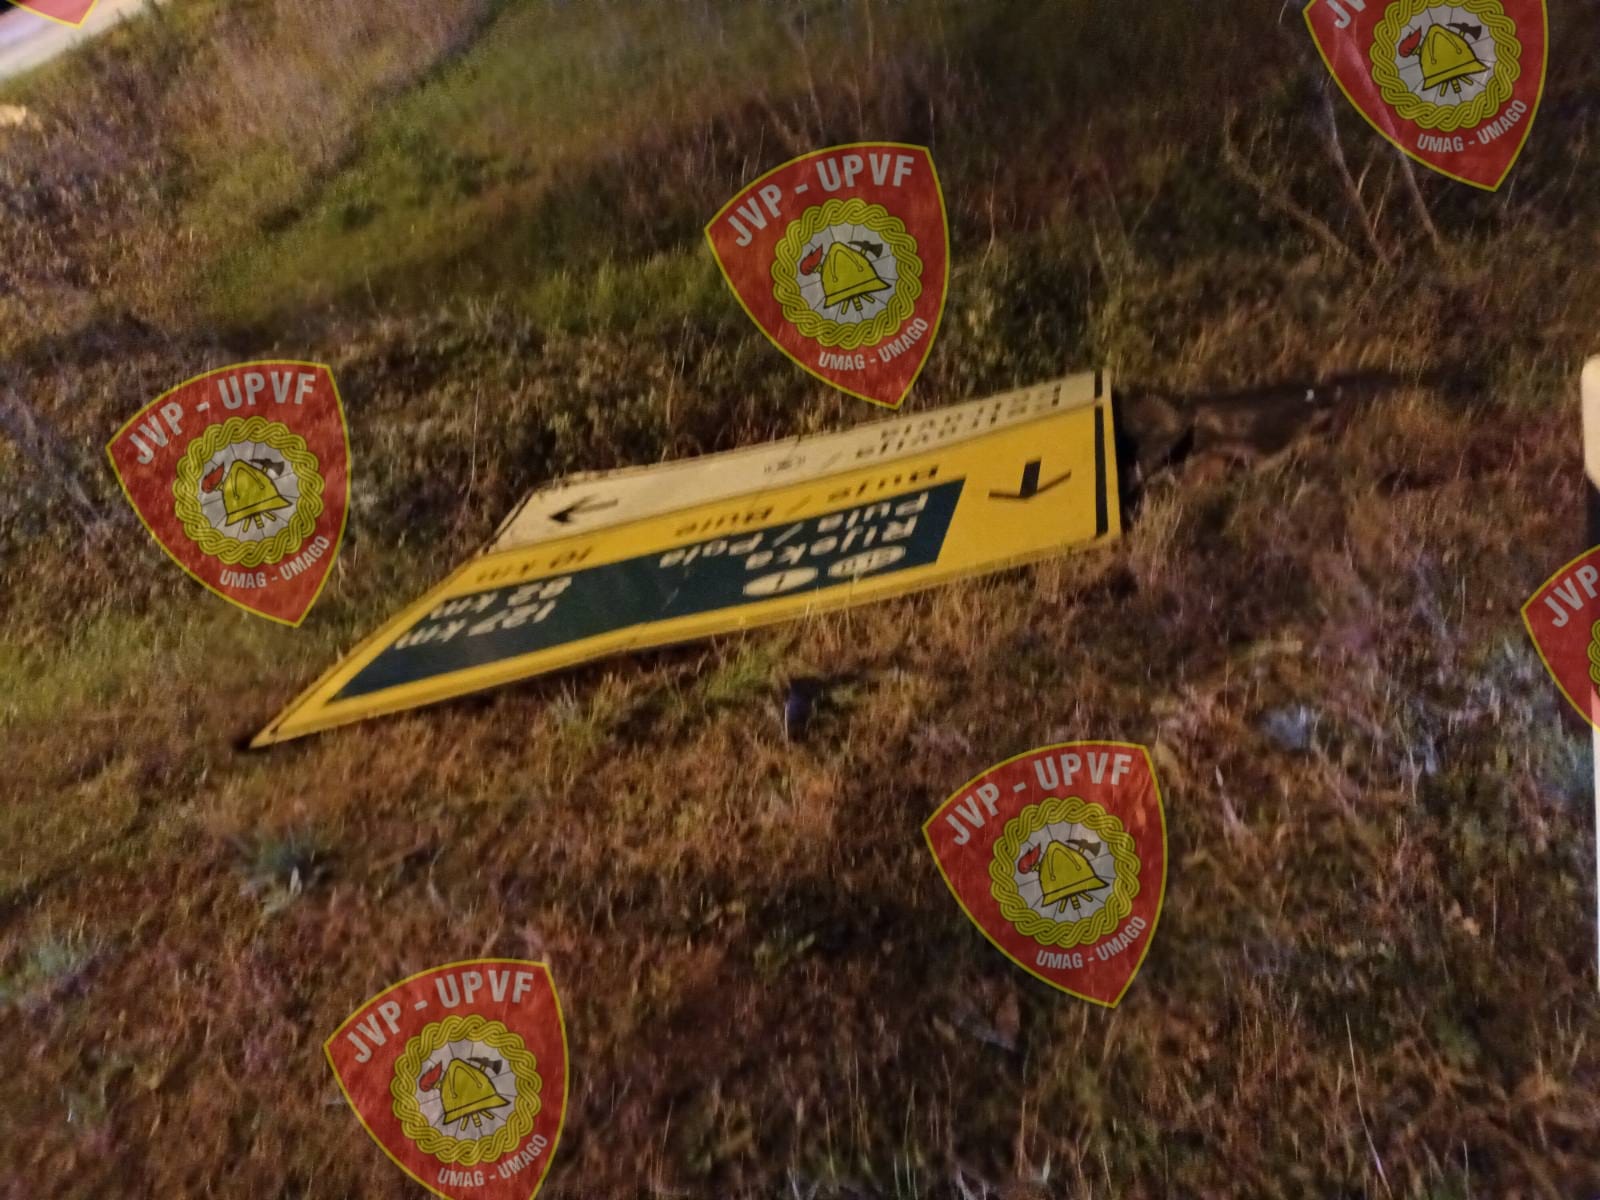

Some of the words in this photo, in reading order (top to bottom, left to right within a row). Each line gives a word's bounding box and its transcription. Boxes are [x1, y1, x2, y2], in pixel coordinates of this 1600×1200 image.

[817, 492, 928, 532] Pula
[745, 515, 918, 570] Rijeka
[430, 592, 498, 620] km
[395, 618, 467, 649] km
